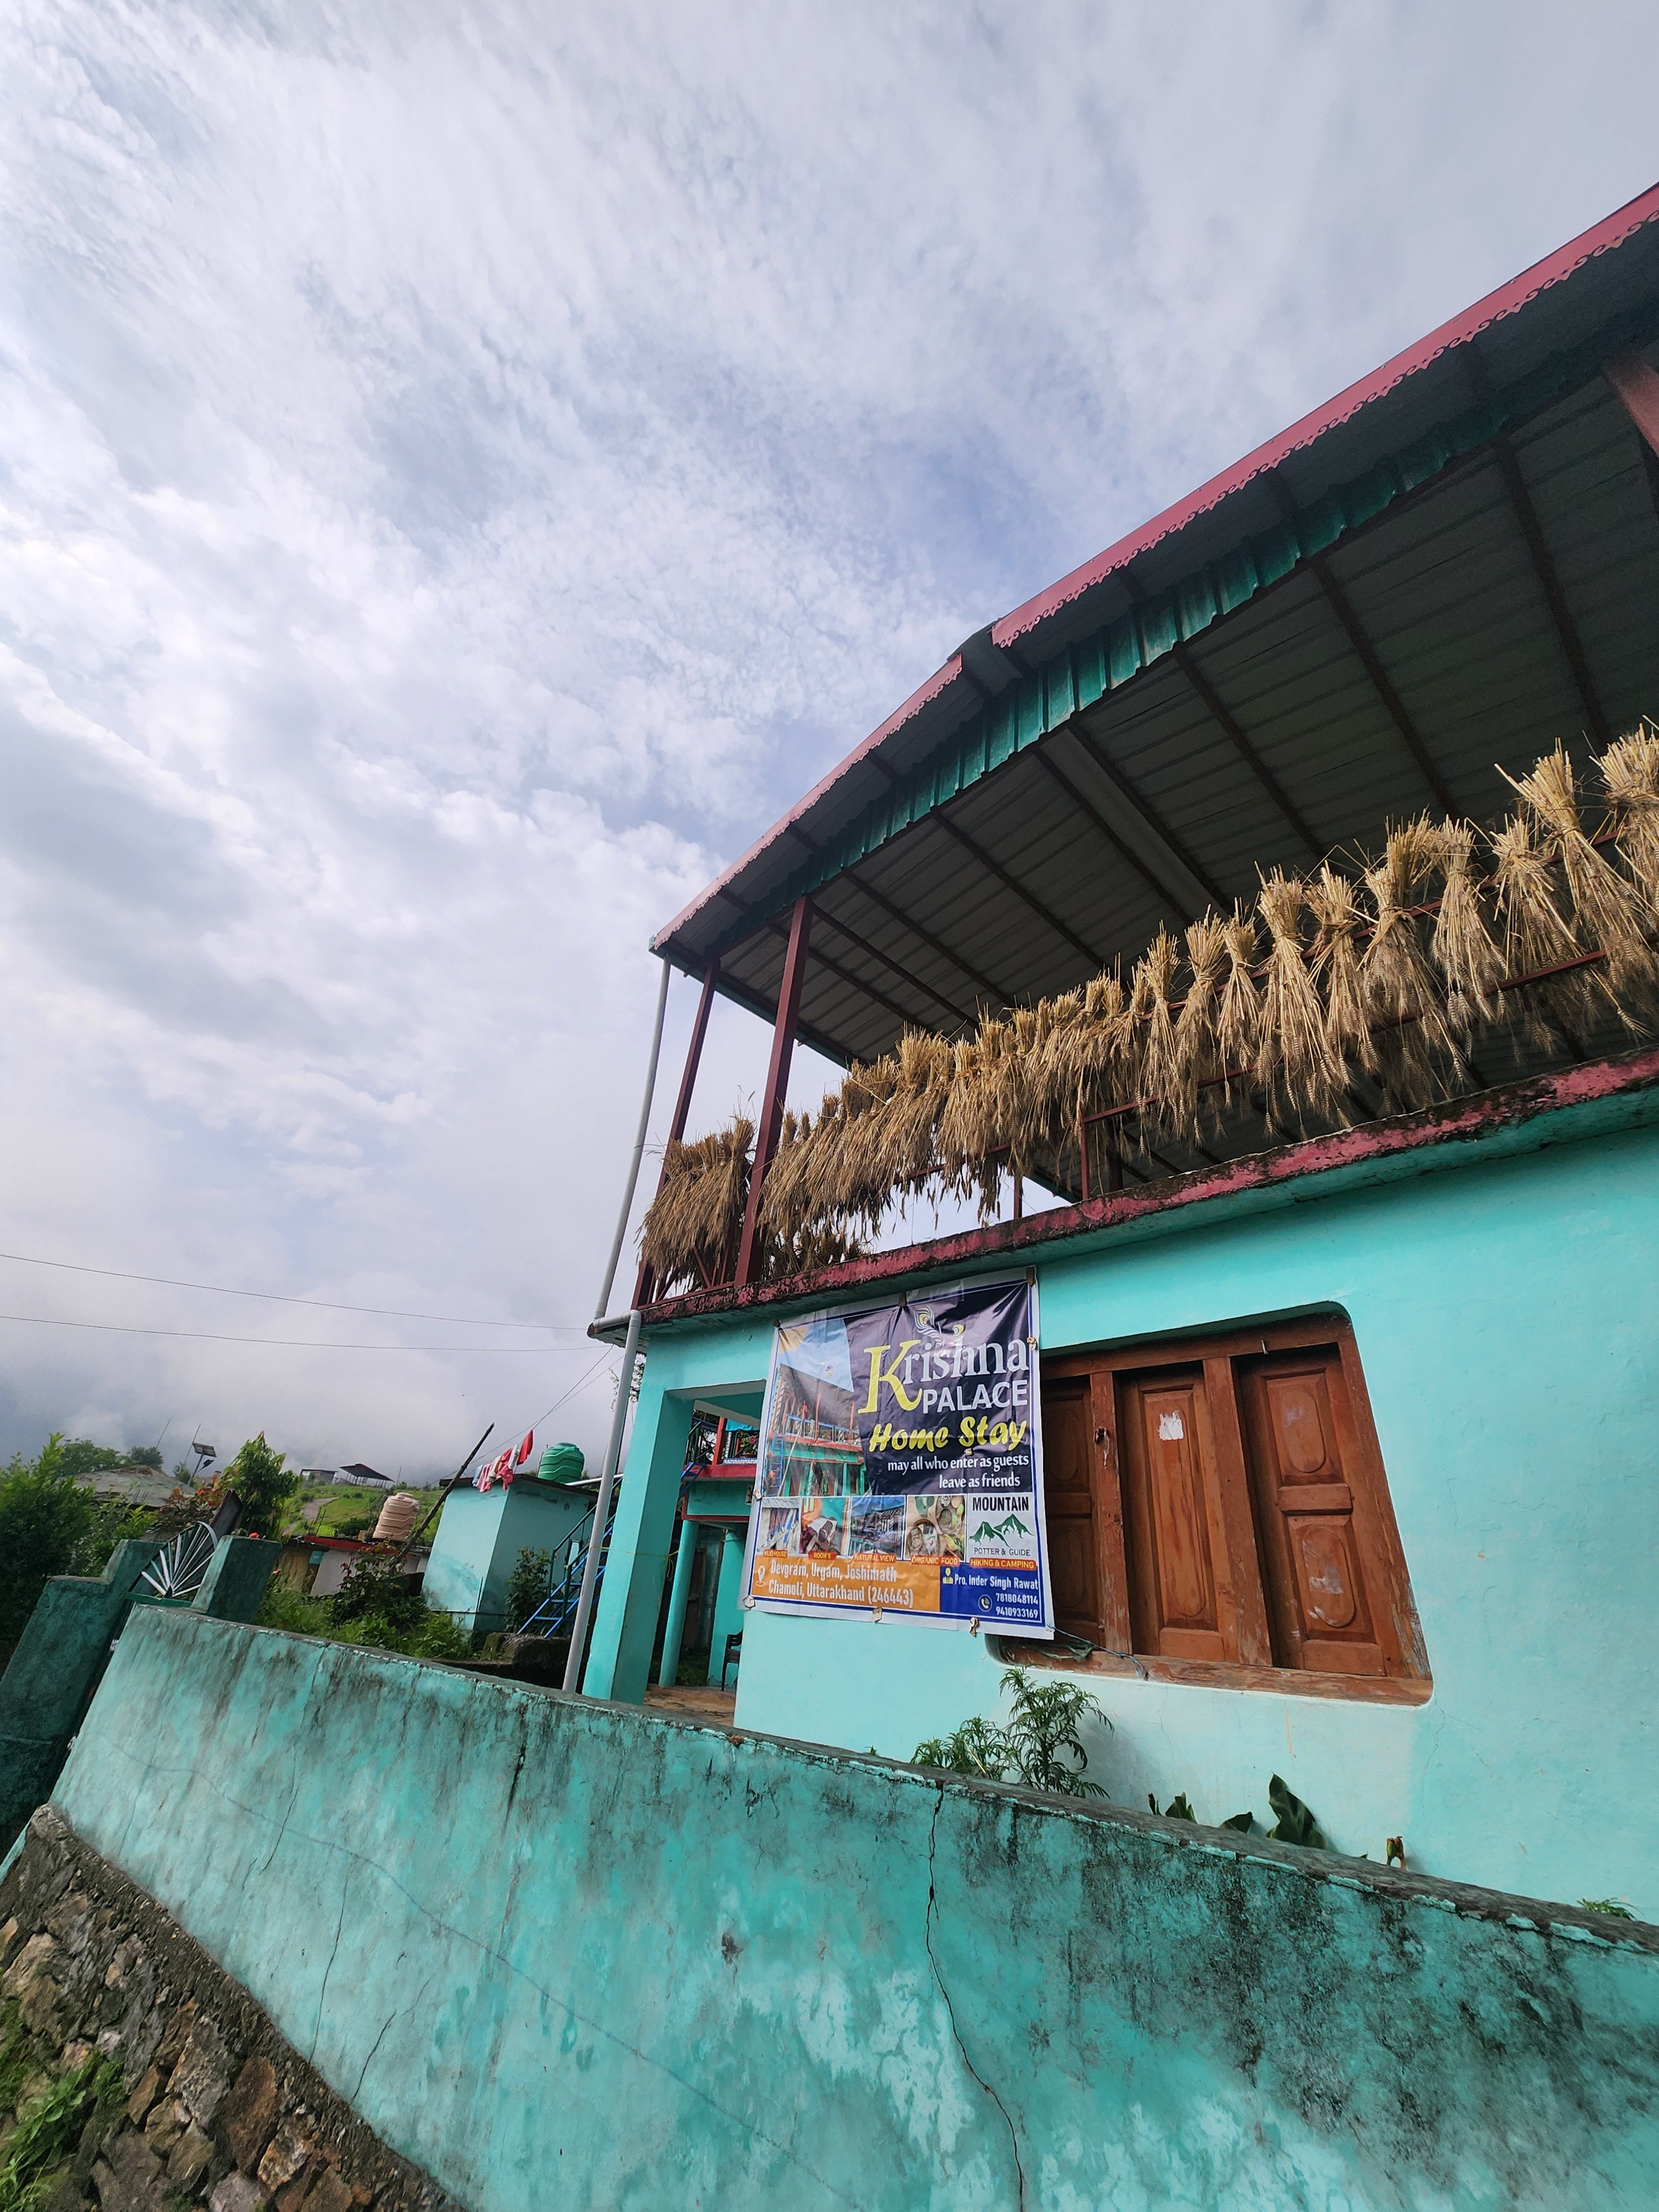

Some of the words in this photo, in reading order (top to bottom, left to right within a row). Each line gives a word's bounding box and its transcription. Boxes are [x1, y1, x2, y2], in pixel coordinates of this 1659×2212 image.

[858, 1336, 1029, 1413] Krishna
[922, 1379, 1027, 1413] PALACE
[869, 1422, 949, 1452] Home
[958, 1416, 1027, 1451] Stay
[888, 1461, 909, 1475] may
[911, 1456, 923, 1470] all
[925, 1455, 948, 1469] who
[950, 1457, 978, 1469] enter
[979, 1457, 992, 1468] as
[993, 1454, 1029, 1472] guests
[939, 1474, 967, 1489] leave
[968, 1477, 980, 1488] as
[982, 1471, 1021, 1488] friends
[972, 1496, 1029, 1511] MOUNTAIN
[854, 1553, 879, 1562] NATURAL
[971, 1558, 994, 1567] HIKING
[1001, 1560, 1034, 1569] CAMPING
[770, 1559, 809, 1579] Devgram,
[811, 1562, 842, 1582] Urgam,
[845, 1564, 897, 1582] Joshimath
[954, 1573, 968, 1585] Pro.
[969, 1574, 988, 1587] Inder
[990, 1575, 1011, 1590] Singh
[1014, 1577, 1039, 1590] Rawat
[769, 1579, 804, 1599] Chamoli,
[807, 1582, 865, 1601] Uttarakhand
[868, 1585, 914, 1609] (246443)
[995, 1593, 1039, 1605] 7818048114
[995, 1606, 1039, 1619] 9410933169
